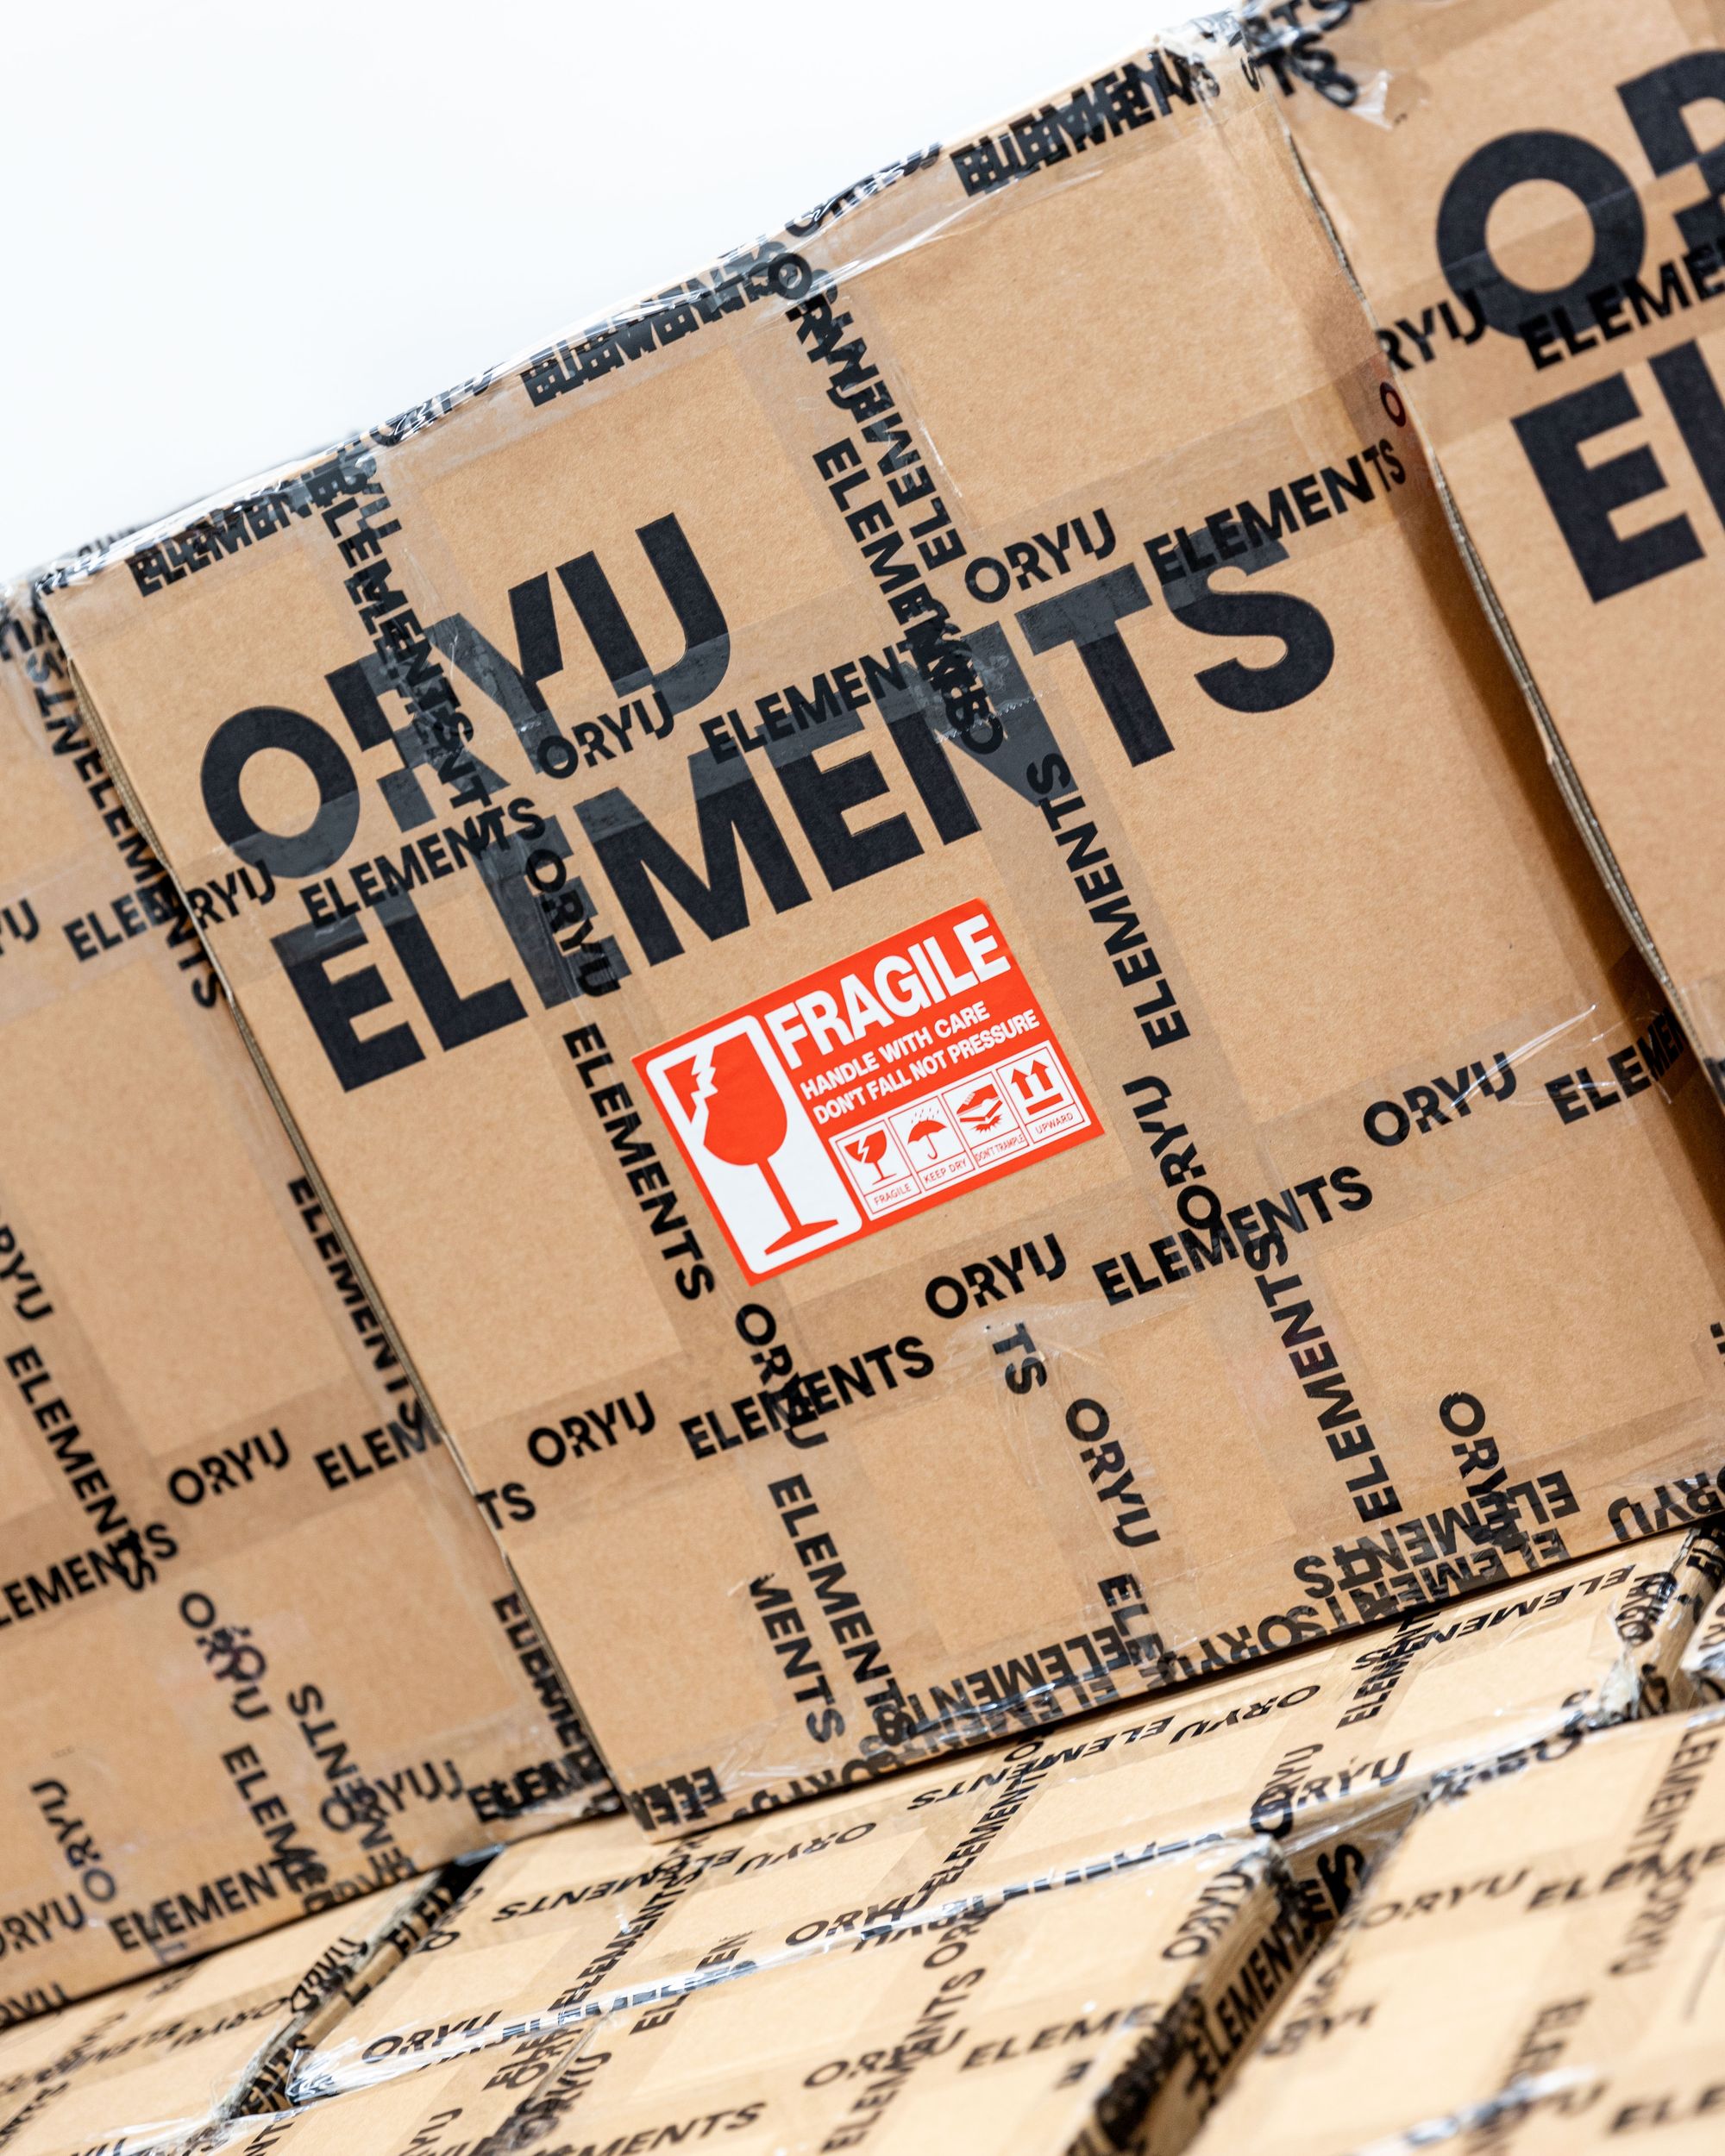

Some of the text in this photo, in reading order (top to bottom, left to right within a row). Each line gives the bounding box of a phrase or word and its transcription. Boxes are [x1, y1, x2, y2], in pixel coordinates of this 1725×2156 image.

[200, 512, 731, 879] ORYU
[298, 796, 546, 928] ELEMENTS
[536, 690, 675, 780] ORYU
[964, 507, 1117, 604] ORYU
[1143, 438, 1407, 586] ELEMENTS
[270, 520, 1336, 1094] ELEMENTS
[524, 849, 622, 998] ORYU
[764, 913, 1012, 1072] FRAGILE
[799, 1000, 991, 1101] HANDLE WITH CARE
[812, 1008, 1041, 1125] DON'T FALL NOT PRESSURE
[1034, 1111, 1075, 1135] UPWARD
[563, 1023, 716, 1300] ELEMENTS
[873, 1183, 913, 1206] FRAGILE
[922, 1157, 968, 1185] KEEP DRY
[975, 1133, 1026, 1163] DON'T TRAMPLE
[1026, 753, 1191, 1050] ELEMENTS
[1122, 1075, 1223, 1231] ORYU
[1243, 1229, 1403, 1523] ELEMENTS
[528, 1390, 656, 1467] ORYU
[680, 1336, 934, 1460] ELEMENTS
[925, 1233, 1067, 1319] ORYU
[1092, 1166, 1373, 1306] ELEMENTS
[1363, 1051, 1517, 1147] ORYU
[735, 1303, 829, 1450] ORYU
[4, 1345, 158, 1592] ELEMENTS
[168, 1427, 291, 1506] ORYU
[1065, 1398, 1161, 1548] ORYU
[1608, 1465, 1725, 1542] RYU
[1170, 1683, 1321, 1744] ORYU
[30, 1778, 117, 1903] ORYU
